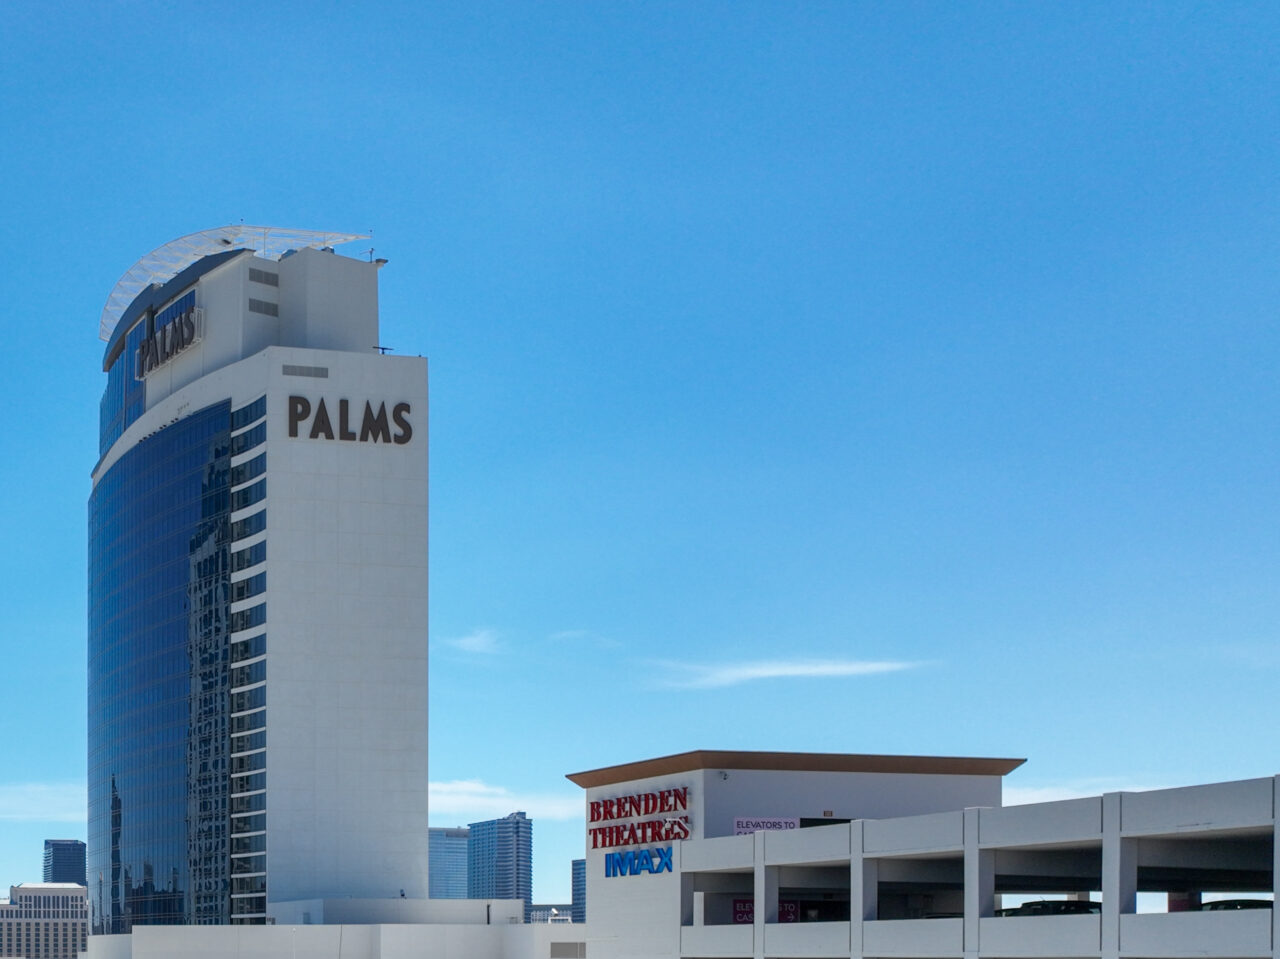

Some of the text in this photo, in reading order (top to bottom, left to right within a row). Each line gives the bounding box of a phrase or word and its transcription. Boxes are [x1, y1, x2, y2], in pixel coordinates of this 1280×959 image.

[139, 306, 195, 377] PALMS
[288, 395, 413, 445] PALMS
[589, 786, 689, 823] BRENDEN
[588, 815, 690, 850] THEATRES
[736, 820, 796, 830] ELEVATORS TO
[605, 846, 673, 878] IMAX
